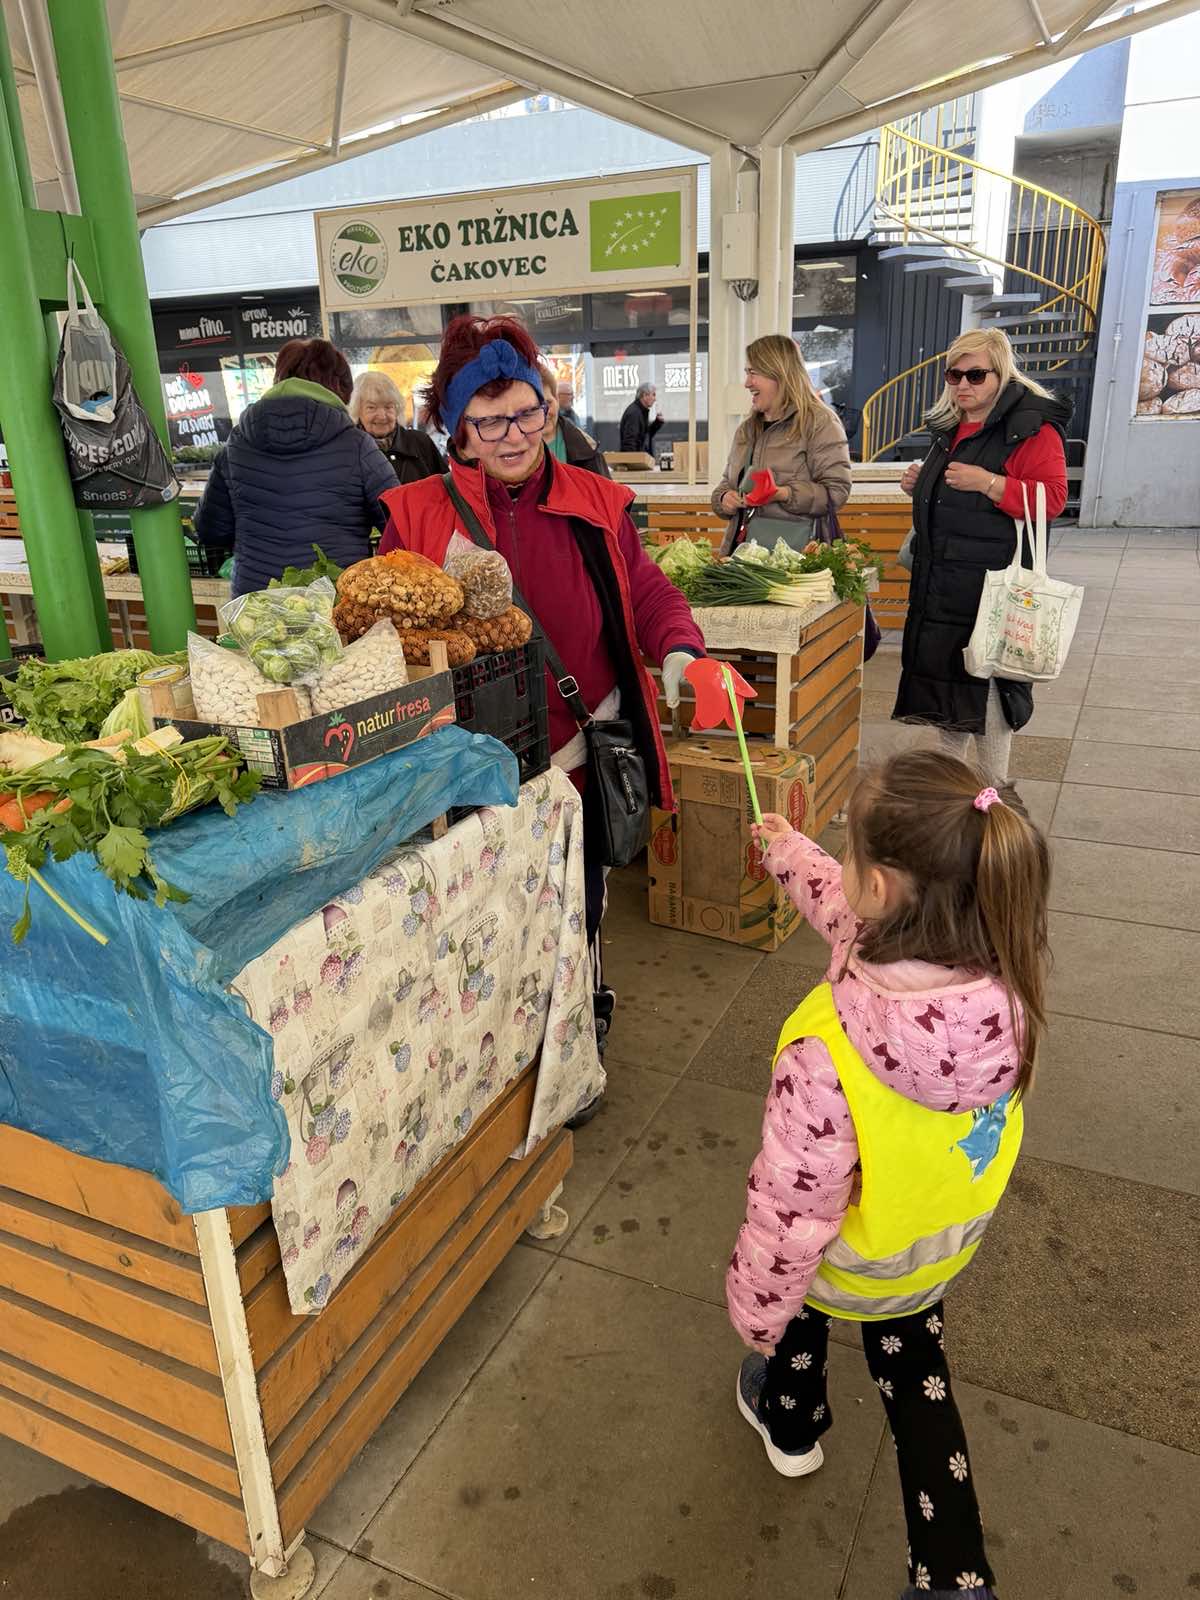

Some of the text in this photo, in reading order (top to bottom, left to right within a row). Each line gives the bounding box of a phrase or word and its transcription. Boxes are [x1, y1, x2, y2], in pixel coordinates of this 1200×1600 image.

[398, 208, 580, 253] EKO TRŽNICA
[339, 245, 378, 275] eko
[430, 255, 548, 284] ČAKOVEC
[251, 316, 308, 338] PEČENO!
[357, 696, 432, 738] naturfresa
